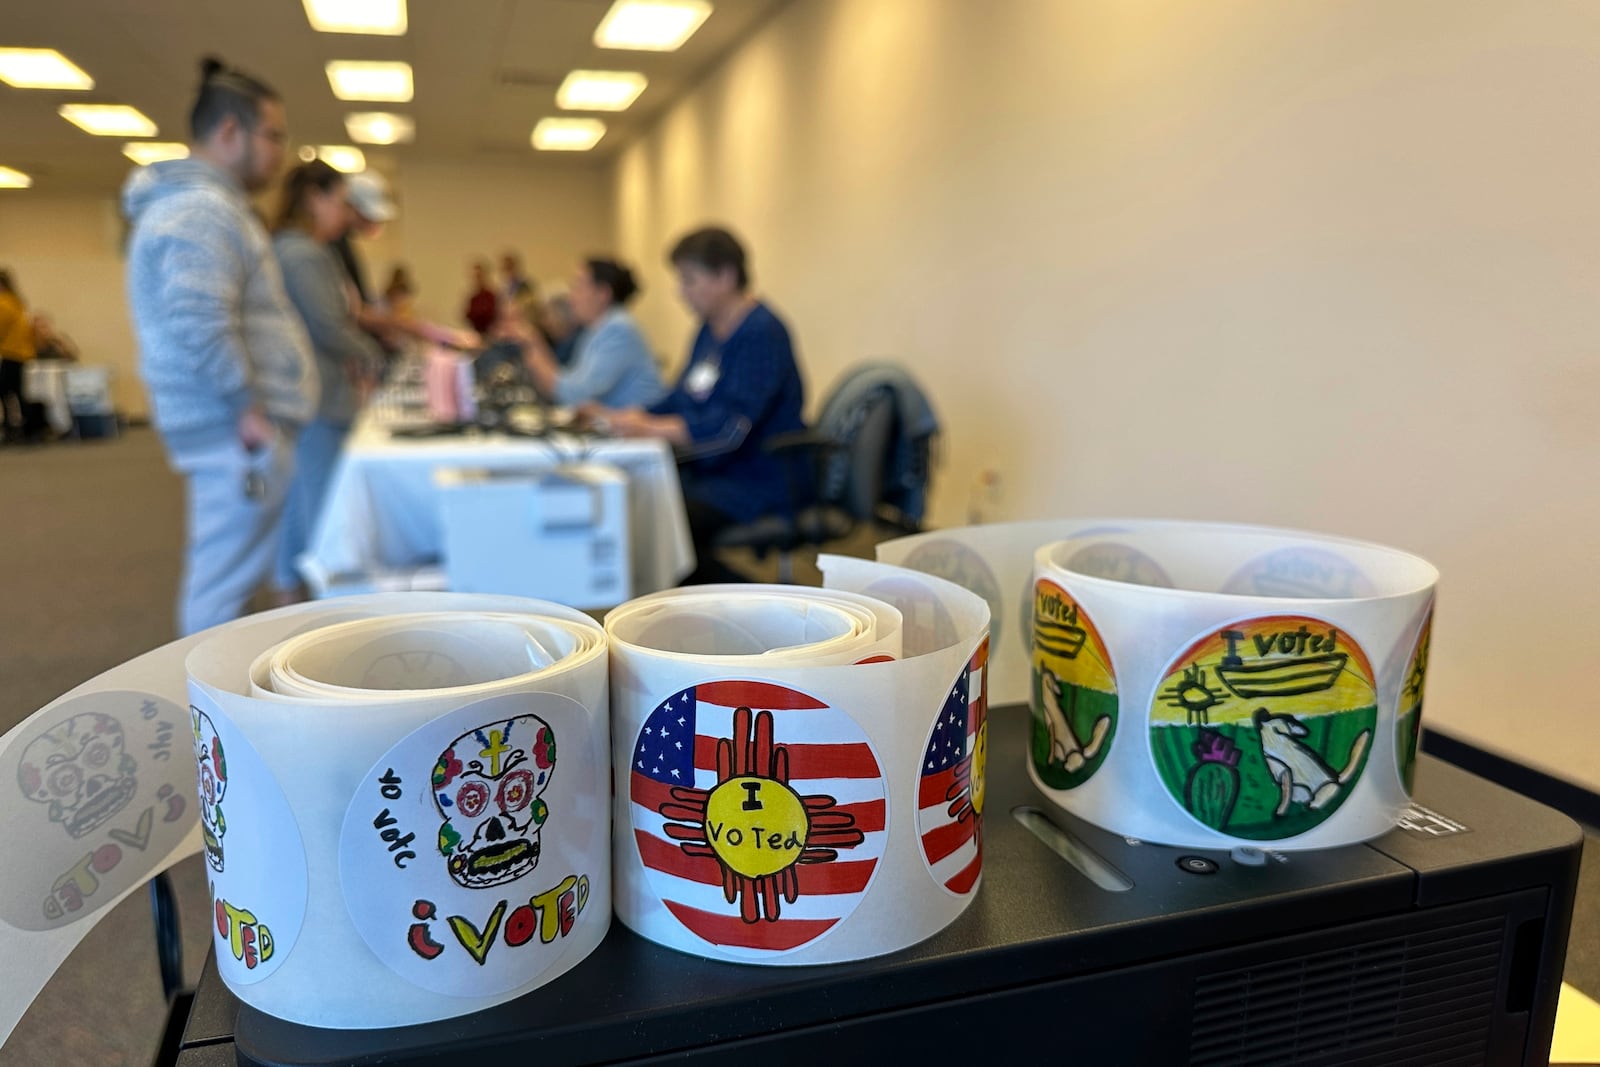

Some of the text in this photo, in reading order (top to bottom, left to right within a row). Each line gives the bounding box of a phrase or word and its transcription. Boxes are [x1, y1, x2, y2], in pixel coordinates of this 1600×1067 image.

[1220, 625, 1337, 666] I voted
[741, 782, 763, 811] I
[212, 880, 274, 970] OTED
[446, 874, 590, 966] VOTED
